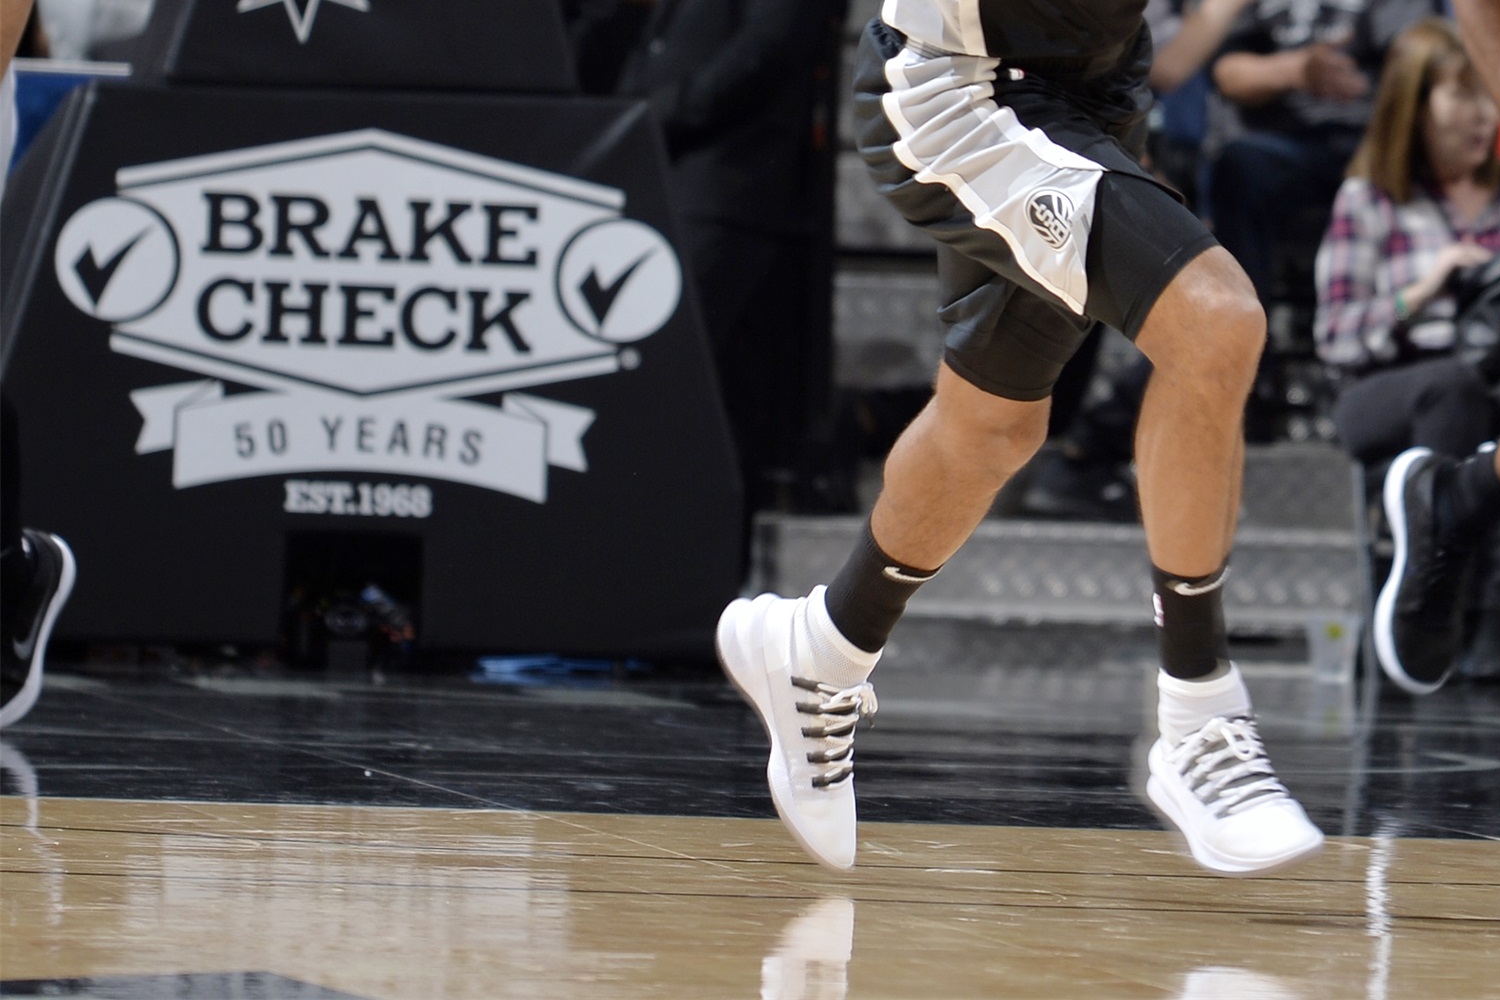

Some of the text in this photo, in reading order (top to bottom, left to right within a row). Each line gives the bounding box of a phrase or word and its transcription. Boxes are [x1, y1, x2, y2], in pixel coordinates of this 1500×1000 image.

[202, 191, 540, 268] BRAKE
[196, 277, 533, 354] CHECK
[234, 414, 484, 466] 50 YEARS
